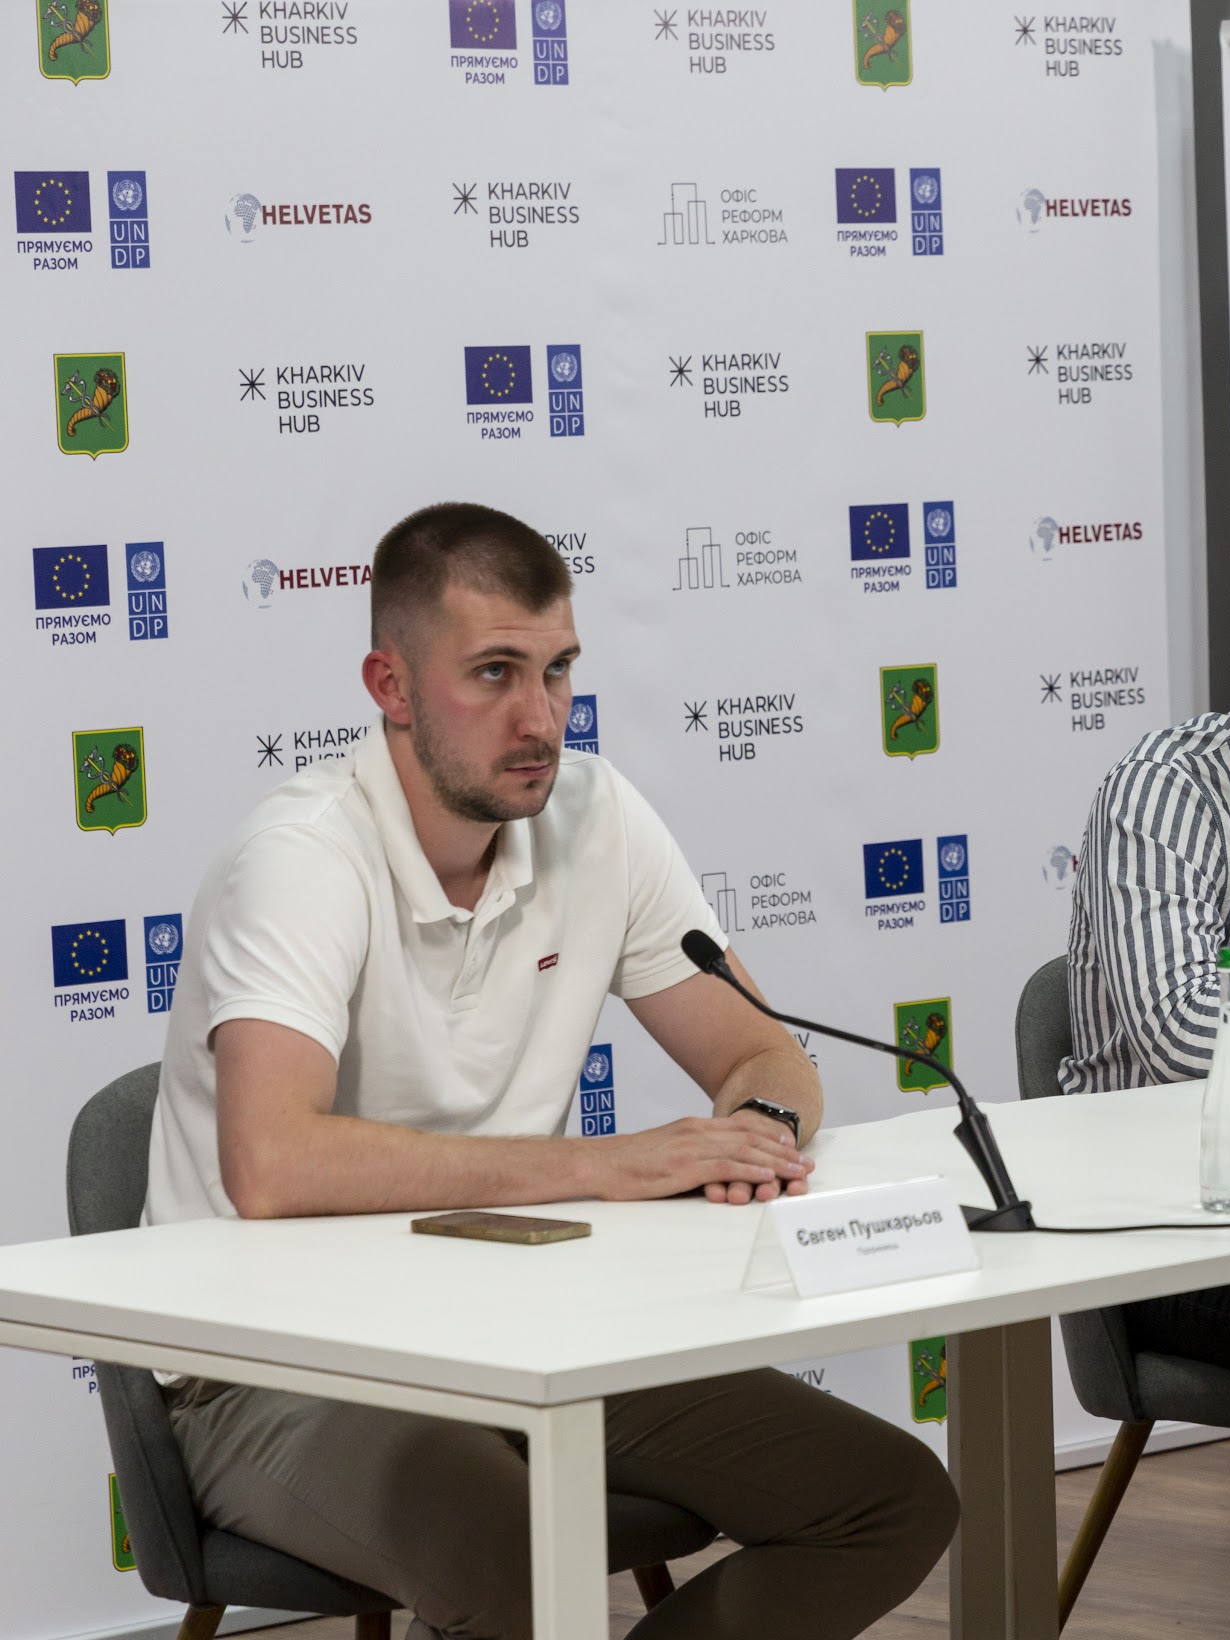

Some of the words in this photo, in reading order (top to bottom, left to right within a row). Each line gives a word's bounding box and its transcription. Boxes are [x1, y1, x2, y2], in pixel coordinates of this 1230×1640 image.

[260, 1, 348, 20] KHARKIV
[688, 10, 766, 27] KHARKIV
[1044, 16, 1116, 33] KHARKIV
[261, 26, 357, 44] BUSINESS
[689, 33, 775, 51] BUSINESS
[536, 42, 565, 59] UN
[1045, 38, 1123, 56] BUSINESS
[262, 51, 303, 68] HUB
[451, 56, 518, 68] ПРЯМУЄМО
[690, 56, 727, 73] HUB
[537, 65, 565, 83] DP
[1046, 60, 1079, 77] HUB
[466, 72, 505, 84] РАЗОМ
[488, 183, 571, 200] KHARKIV
[721, 189, 757, 203] ОФІС
[262, 204, 371, 225] HELVETAS
[489, 206, 579, 224] BUSINESS
[722, 209, 782, 223] РЕФОРМ
[1045, 199, 1132, 217] HELVETAS
[914, 215, 940, 231] UN
[113, 223, 145, 241] UN
[490, 230, 528, 247] HUB
[722, 229, 788, 244] ХАРКОВА
[837, 230, 898, 241] ПРЯМУЄМО
[17, 240, 93, 253] ПРЯМУЄМО
[850, 246, 886, 257] РАЗОМ
[915, 236, 940, 253] DP
[34, 258, 78, 270] РАЗОМ
[114, 248, 146, 266] DP
[1057, 343, 1126, 360] KHARKIV
[703, 353, 780, 371] KHARKIV
[277, 364, 365, 384] KHARKIV
[1058, 364, 1132, 382] BUSINESS
[704, 375, 788, 395] BUSINESS
[278, 388, 374, 409] BUSINESS
[552, 394, 580, 411] UN
[1059, 387, 1092, 404] HUB
[467, 411, 533, 424] ПРЯМУЄМО
[705, 400, 741, 418] HUB
[279, 415, 320, 433] HUB
[553, 416, 581, 434] DP
[482, 427, 520, 439] РАЗОМ
[735, 531, 771, 546] ОФІС
[1058, 522, 1142, 544] HELVETAS
[737, 550, 796, 566] РЕФОРМ
[927, 548, 954, 565] UN
[279, 565, 371, 590] HELVETA
[737, 569, 802, 586] ХАРКОВА
[851, 565, 911, 578] ПРЯМУЄМО
[928, 569, 953, 587] DP
[864, 581, 899, 593] РАЗОМ
[131, 594, 163, 613] UN
[36, 614, 111, 629] ПРЯМУЄМО
[133, 618, 164, 638] DP
[52, 631, 96, 645] РАЗОМ
[1070, 667, 1138, 688] KHARKIV
[718, 694, 795, 716] KHARKIV
[1071, 688, 1145, 710] BUSINESS
[719, 716, 803, 739] BUSINESS
[1072, 713, 1105, 731] HUB
[294, 725, 370, 750] KHARKI
[720, 743, 755, 762] HUB
[750, 873, 785, 889] ОФІС
[941, 882, 967, 899] UN
[752, 891, 811, 909] РЕФОРМ
[865, 900, 925, 916] ПРЯМУЄМО
[752, 910, 816, 929] ХАРКОВА
[942, 903, 968, 921] DP
[878, 917, 913, 930] РАЗОМ
[55, 988, 129, 1007] ПРЯМУЄМО
[71, 1006, 114, 1022] РАЗОМ
[583, 1093, 612, 1112] UN
[584, 1115, 612, 1135] DP
[796, 1228, 847, 1246] Євген
[848, 1209, 943, 1240] Пушкарьов
